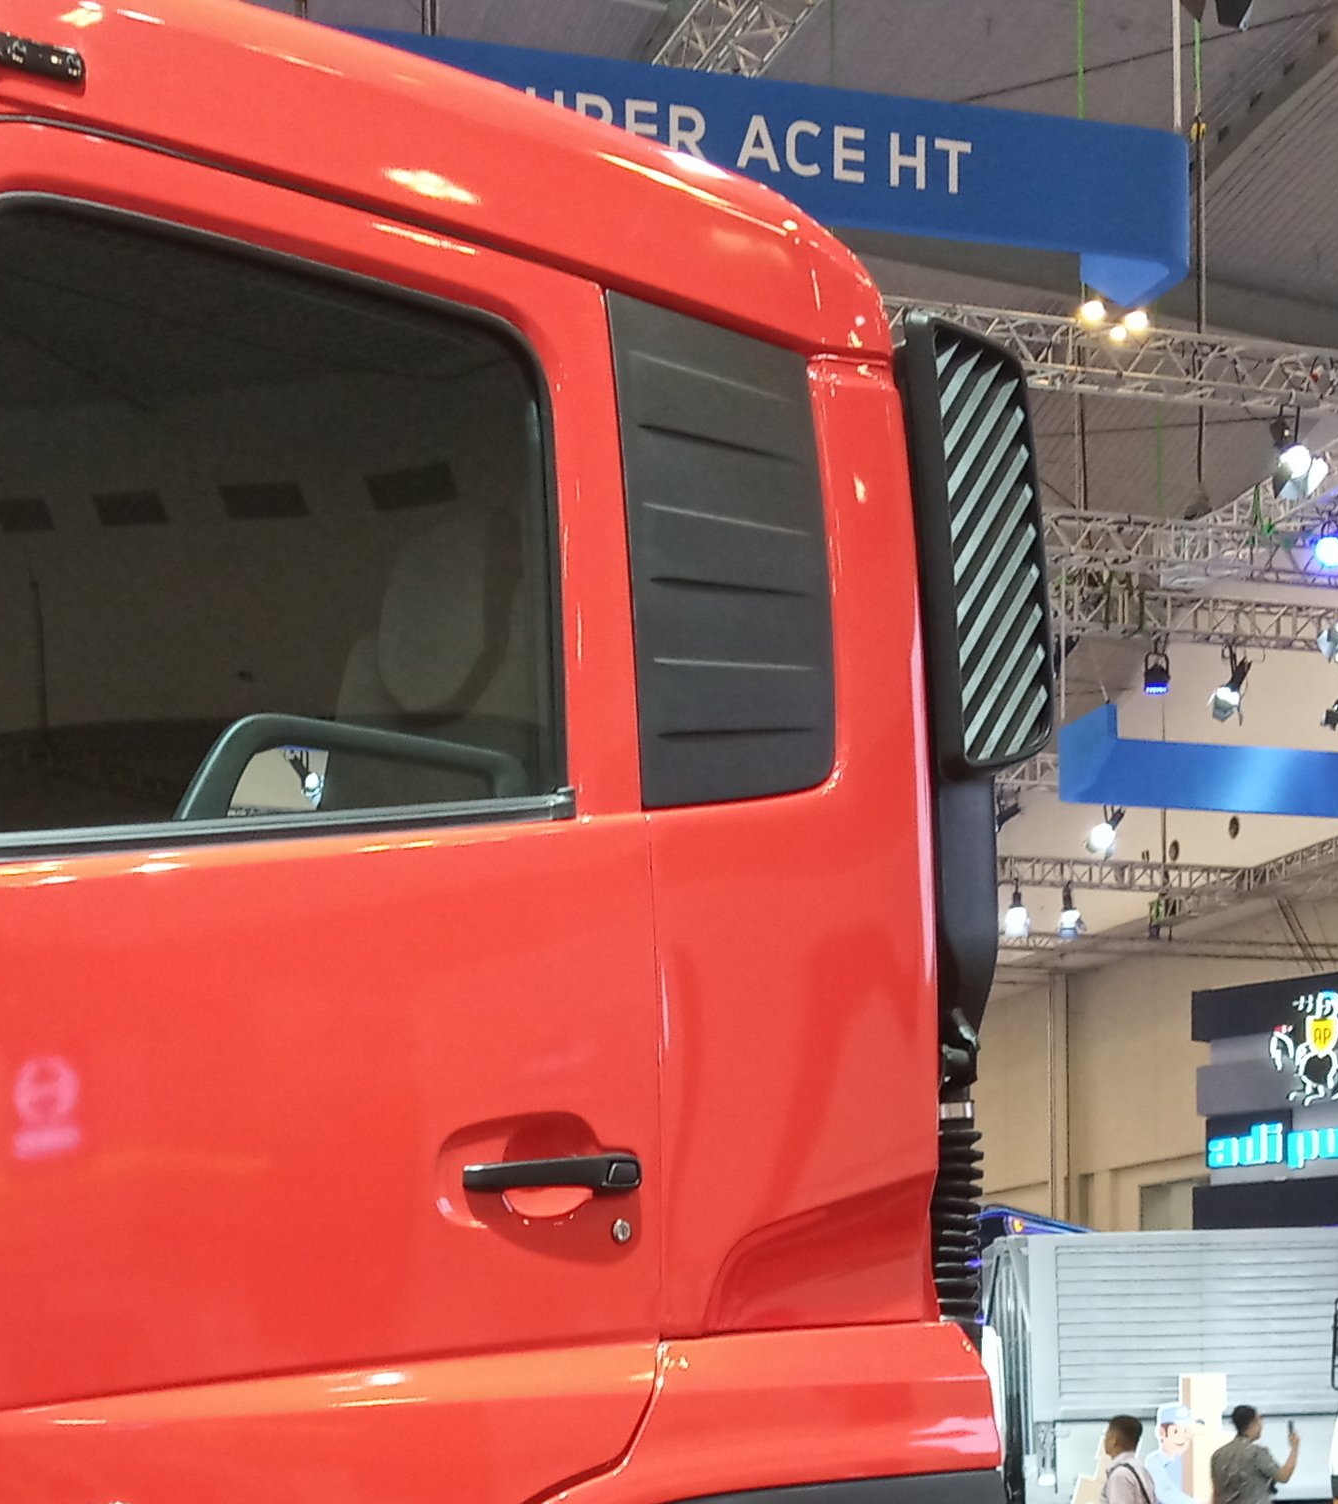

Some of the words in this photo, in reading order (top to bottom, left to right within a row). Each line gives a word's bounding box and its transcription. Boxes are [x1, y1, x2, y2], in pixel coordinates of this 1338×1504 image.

[735, 114, 865, 184] ACE
[889, 132, 973, 195] HT
[1208, 1121, 1283, 1168] adi
